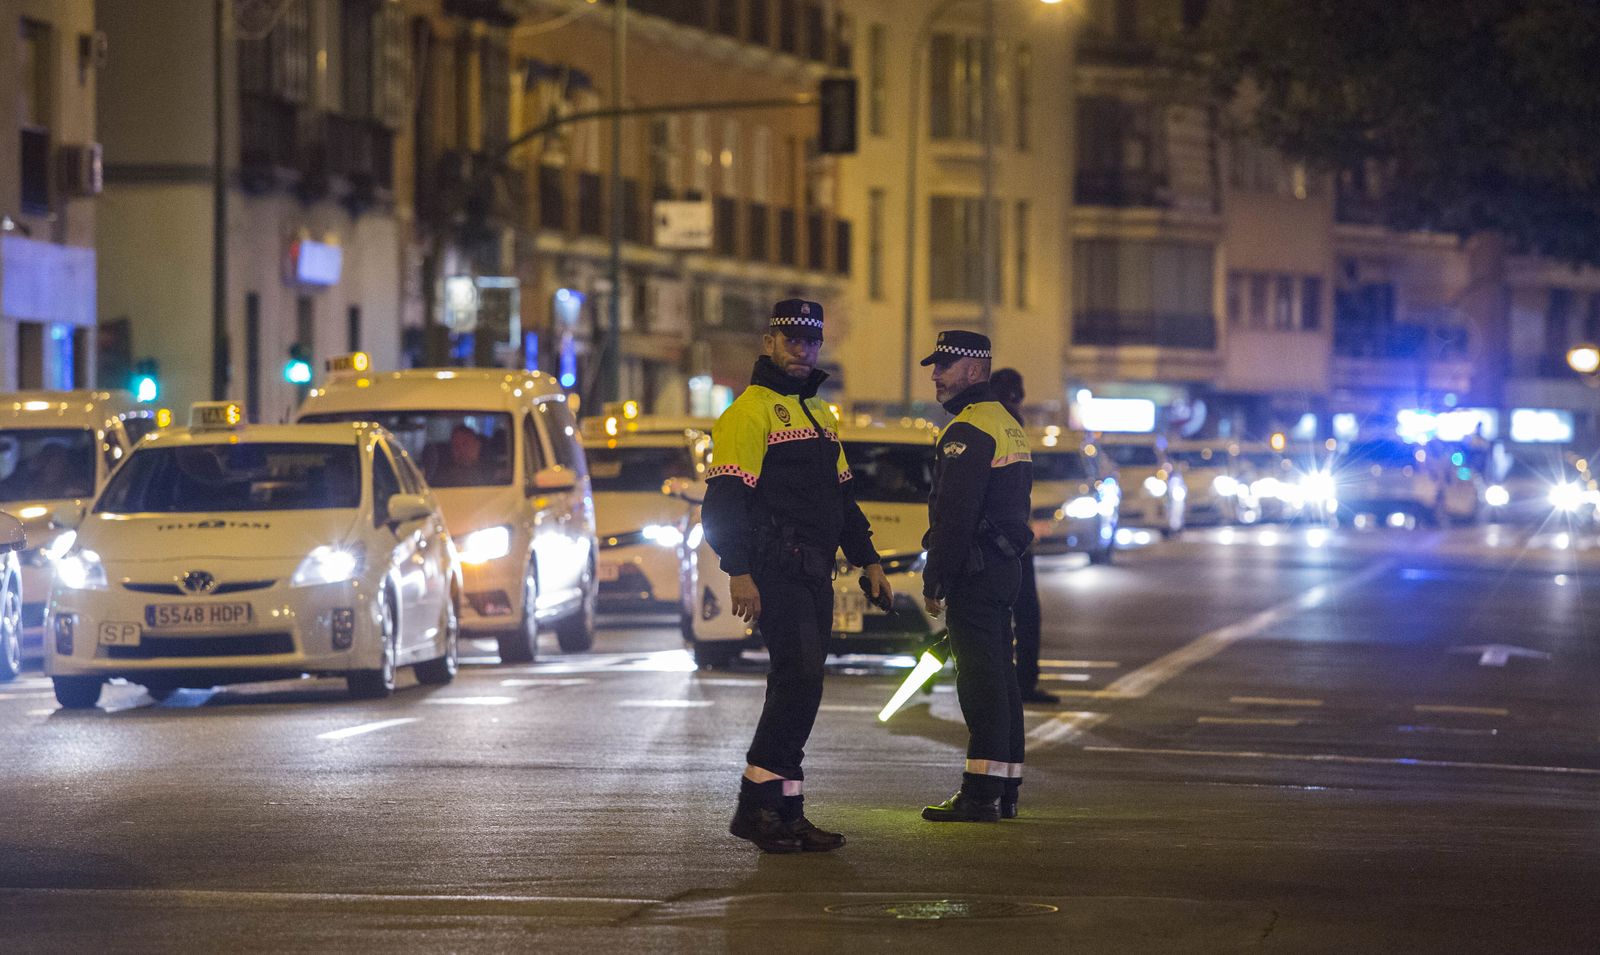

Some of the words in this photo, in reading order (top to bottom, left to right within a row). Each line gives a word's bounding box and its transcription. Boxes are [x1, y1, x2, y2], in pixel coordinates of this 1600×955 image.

[159, 605, 204, 624] 5548
[210, 604, 244, 622] HDP
[104, 624, 136, 643] SP
